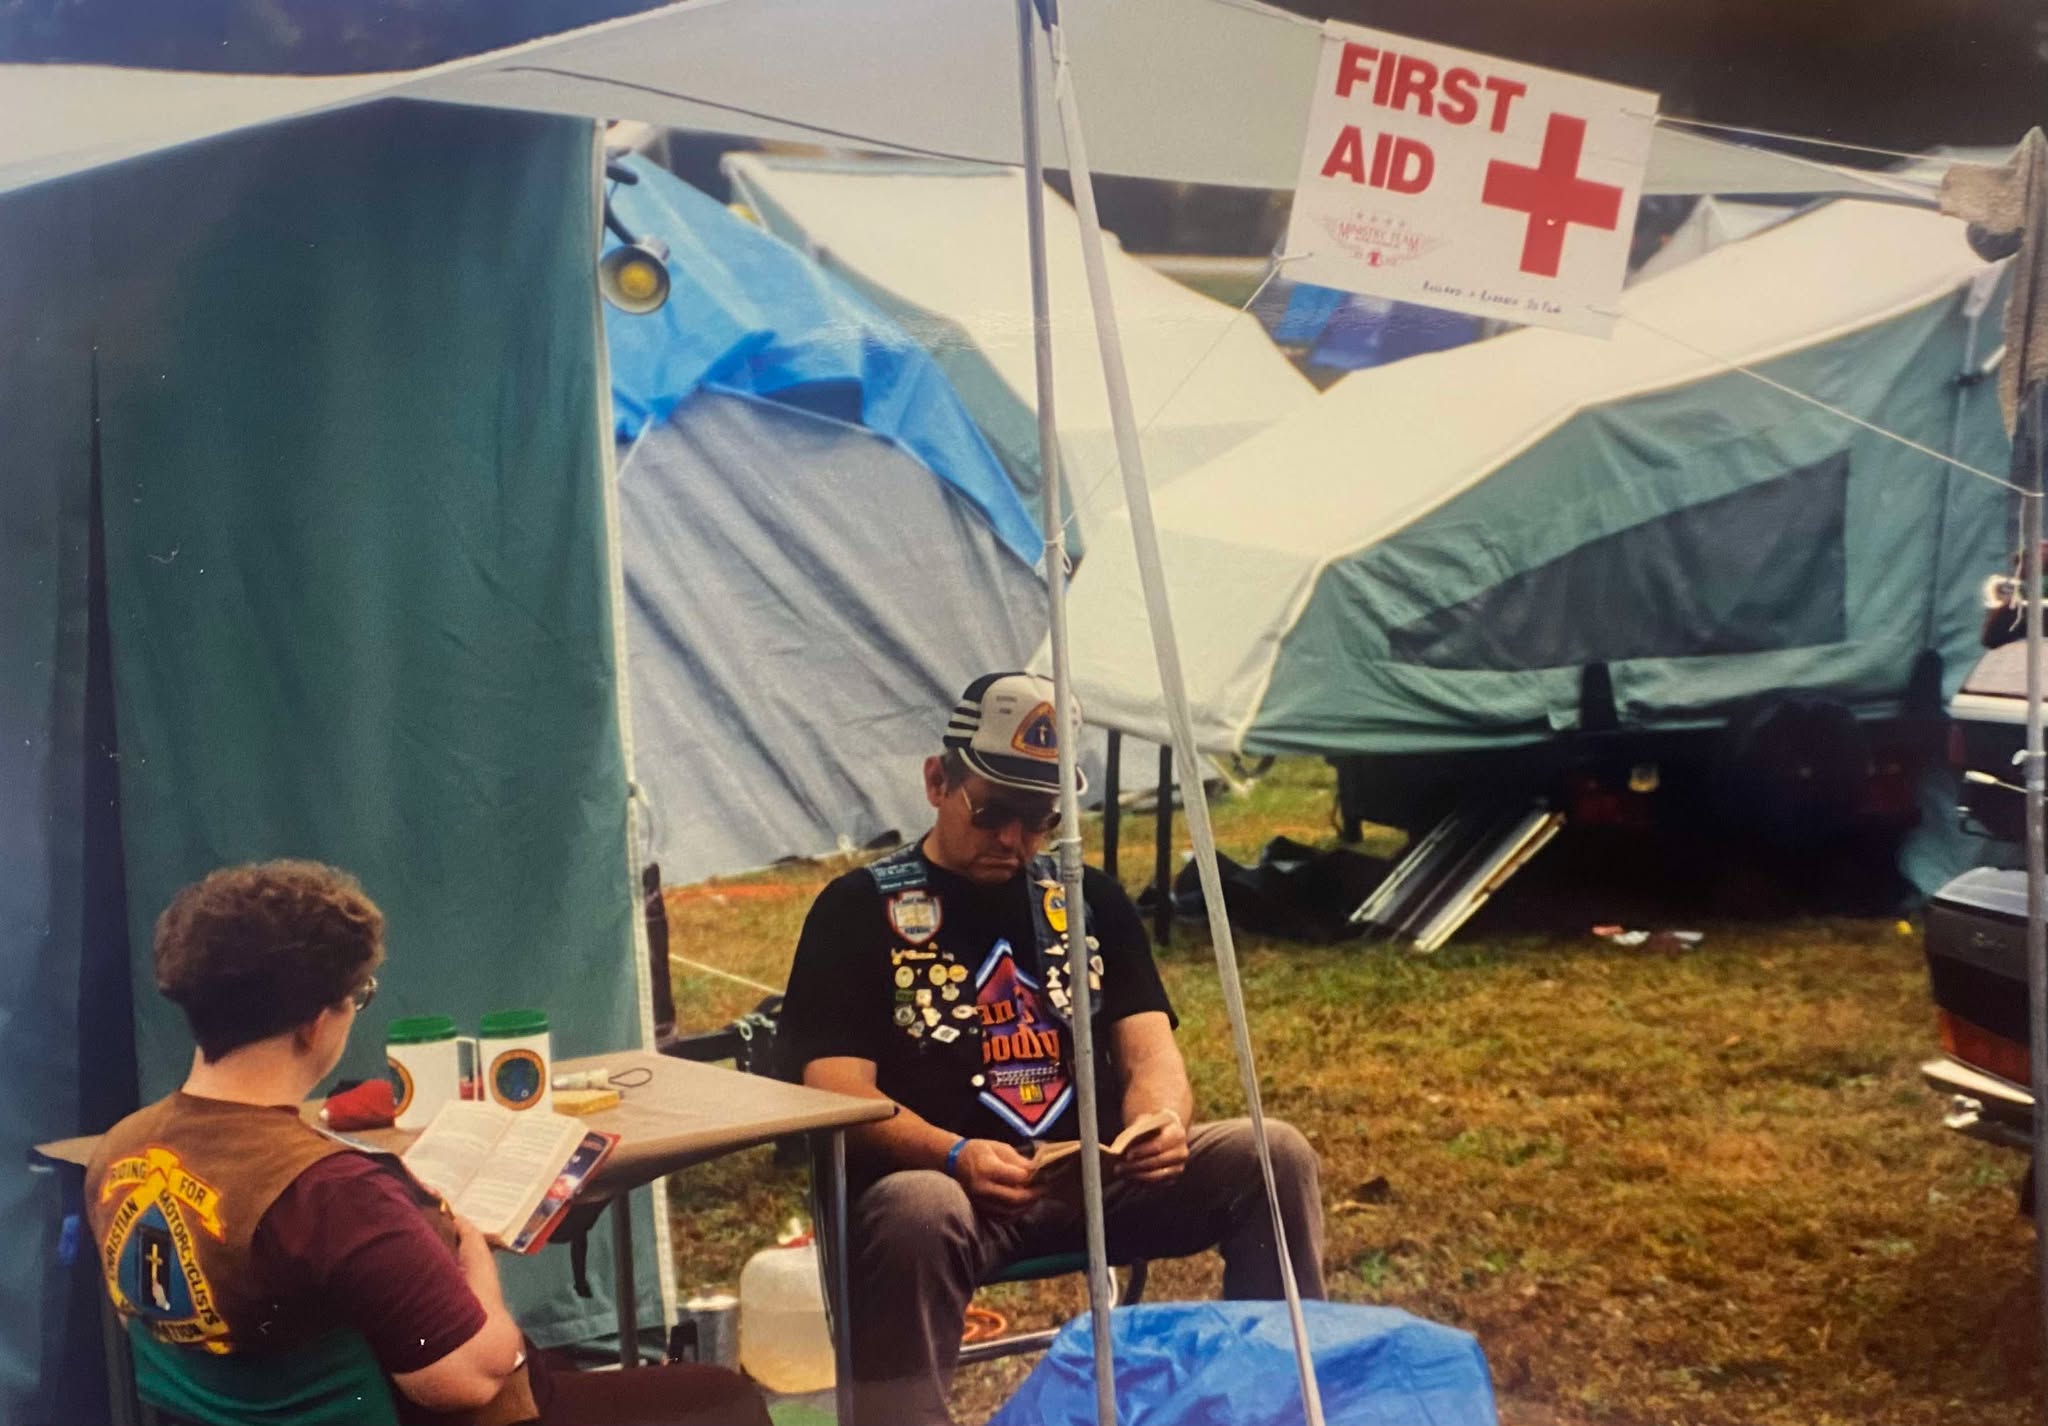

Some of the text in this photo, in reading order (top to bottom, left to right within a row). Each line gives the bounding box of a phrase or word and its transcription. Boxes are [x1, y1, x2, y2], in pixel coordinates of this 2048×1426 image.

[1335, 41, 1527, 133] FIRST
[1320, 124, 1435, 195] AID
[180, 1176, 207, 1206] FOR
